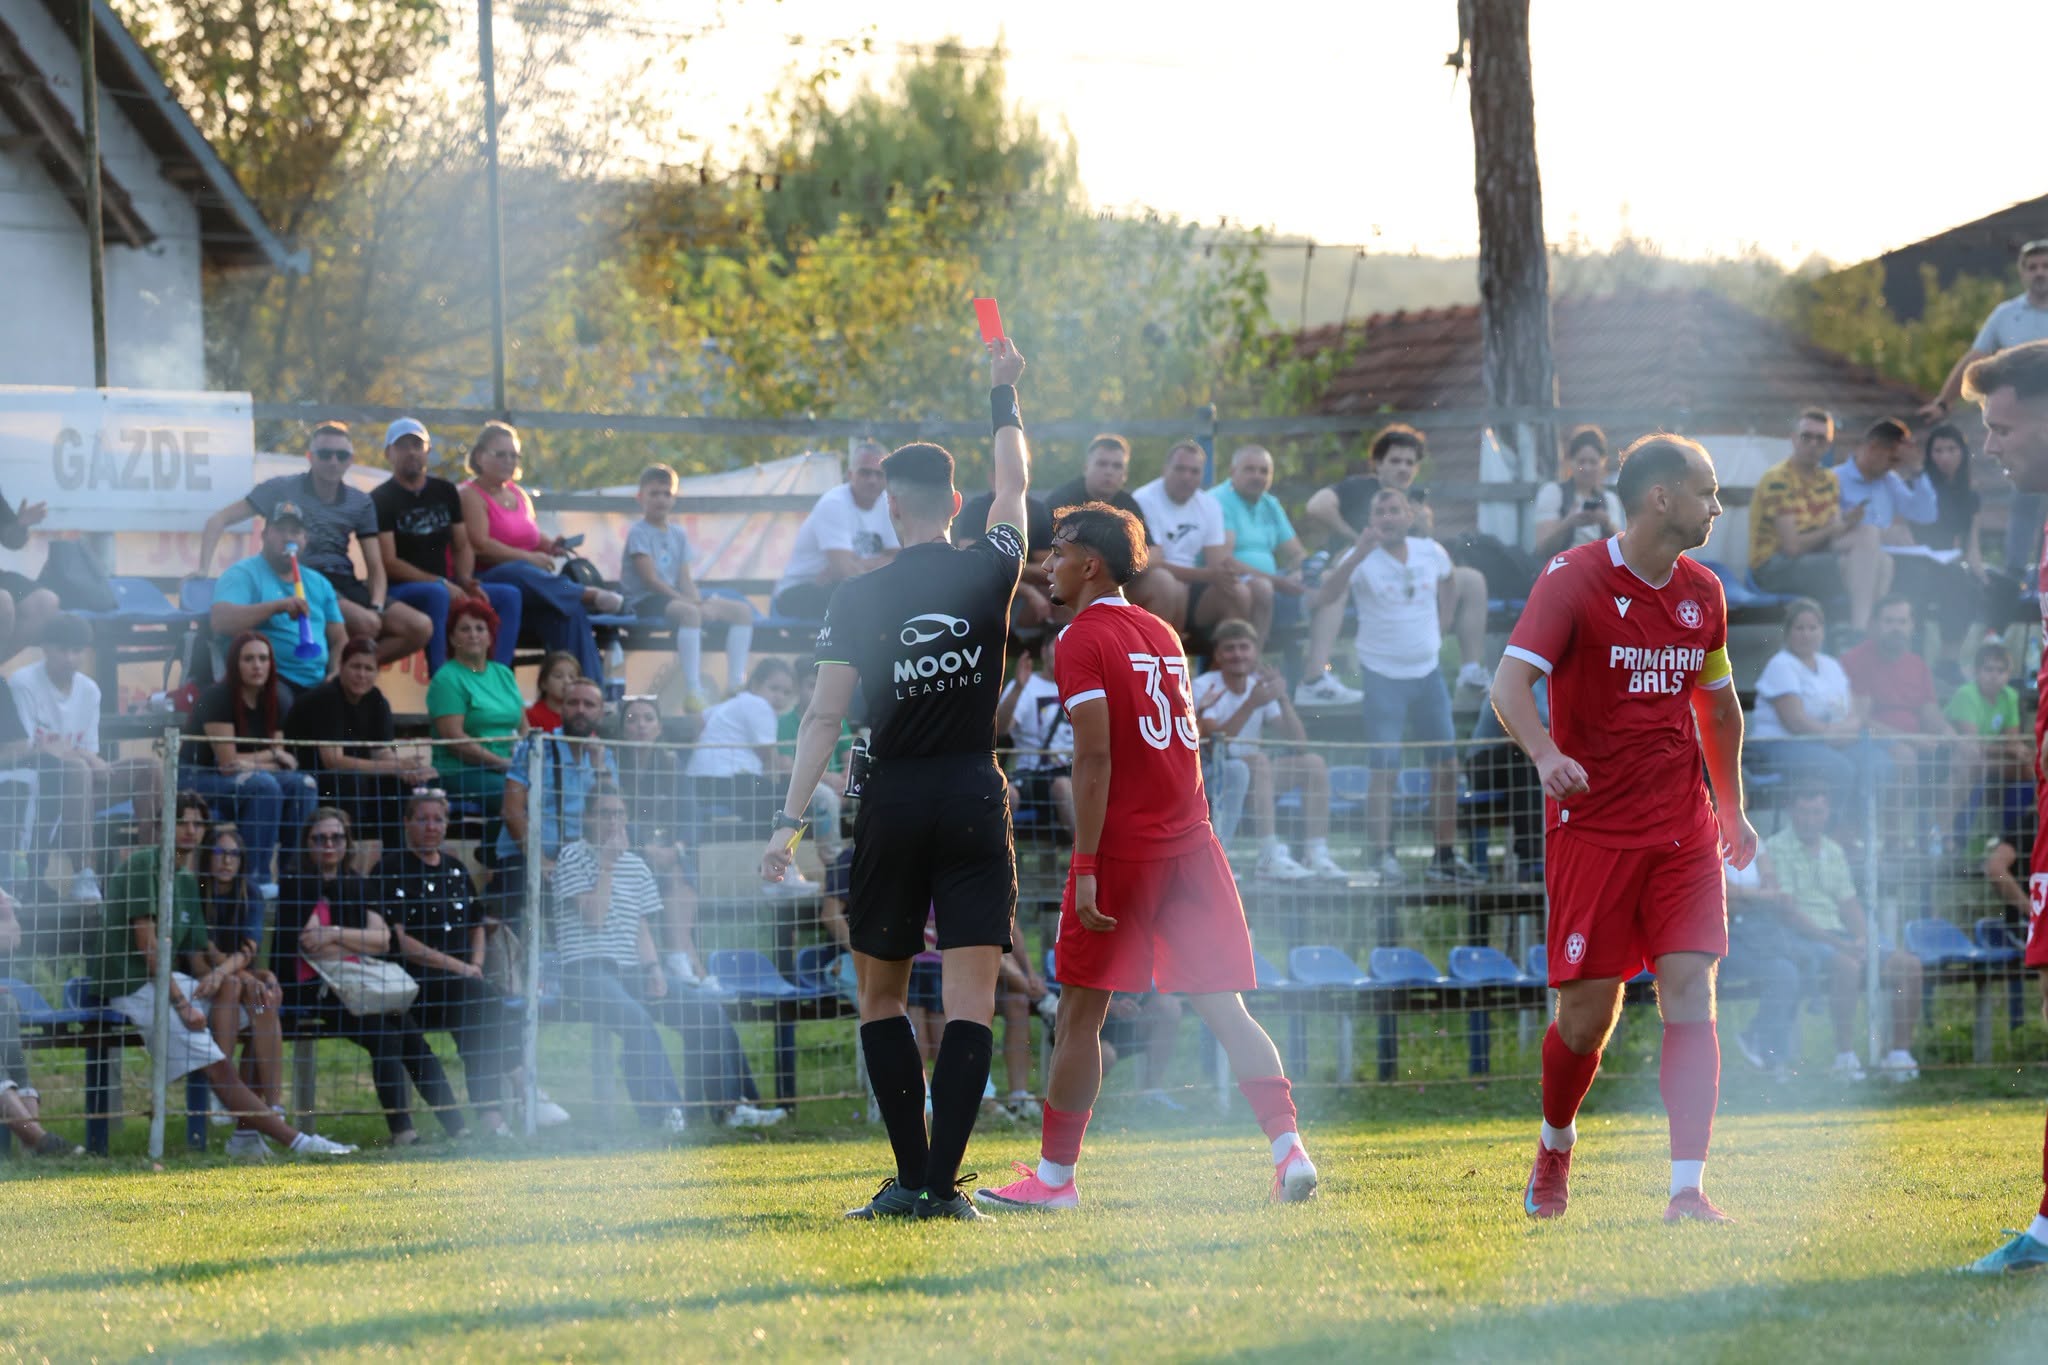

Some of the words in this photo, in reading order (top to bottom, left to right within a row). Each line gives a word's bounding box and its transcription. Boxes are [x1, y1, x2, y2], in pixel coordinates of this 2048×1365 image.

[52, 427, 213, 491] GAZDE
[894, 645, 982, 683] MOOV
[1609, 644, 1705, 671] PRIMĂRIA
[896, 672, 982, 700] LEASING
[1128, 652, 1199, 751] 33
